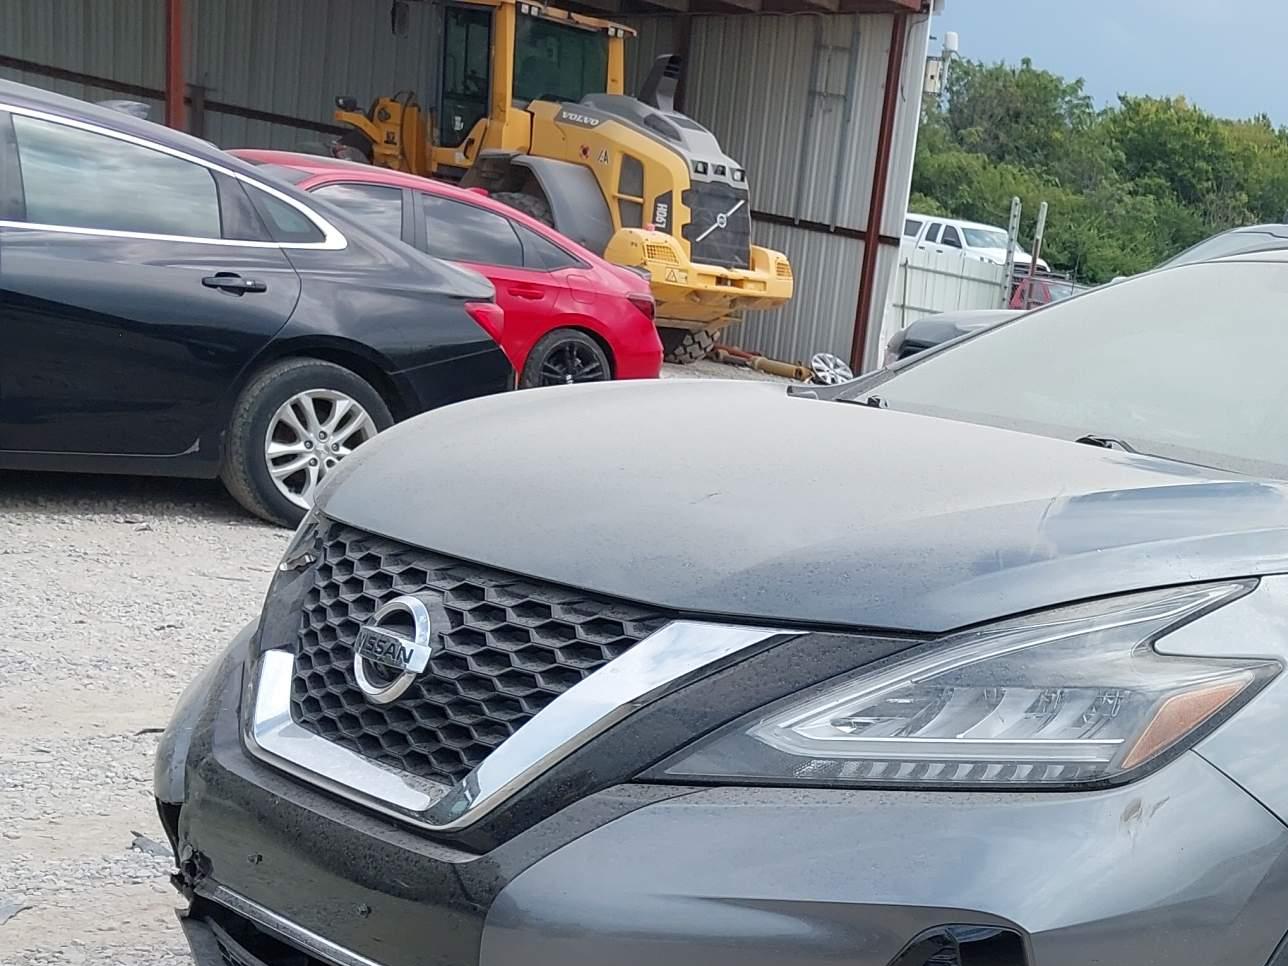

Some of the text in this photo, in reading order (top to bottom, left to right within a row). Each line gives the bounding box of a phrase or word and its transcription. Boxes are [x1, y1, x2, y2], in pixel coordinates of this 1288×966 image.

[562, 111, 600, 126] VOLVO
[655, 203, 668, 228] L90H
[359, 632, 414, 664] NISSAN
